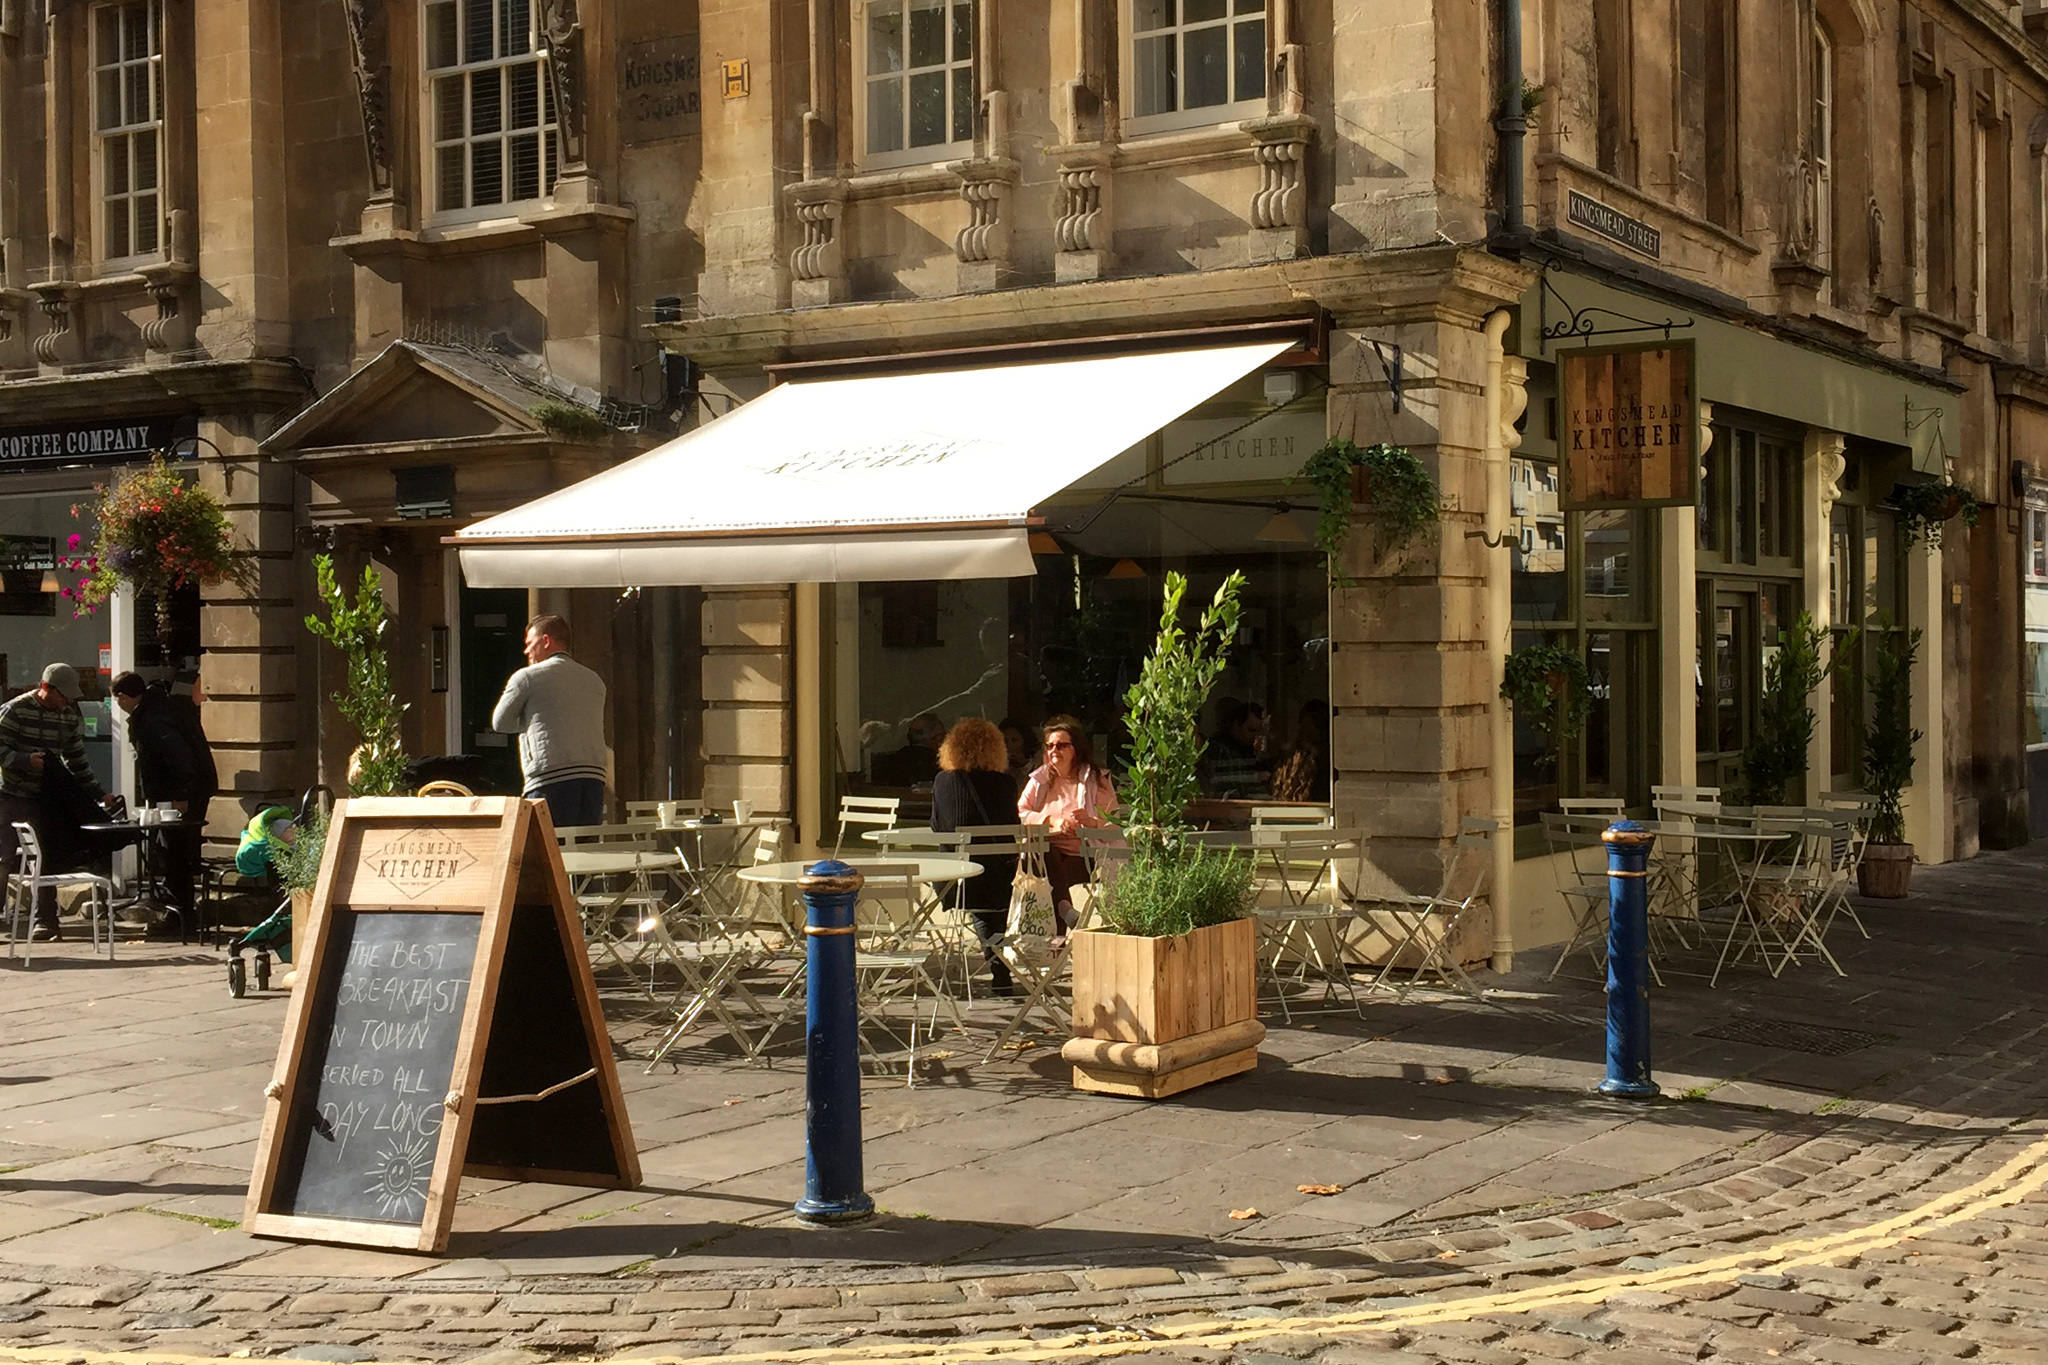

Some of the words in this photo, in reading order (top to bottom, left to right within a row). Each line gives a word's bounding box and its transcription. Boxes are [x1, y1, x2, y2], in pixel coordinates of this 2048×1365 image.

[1571, 196, 1625, 237] KINGSMEAD
[1628, 223, 1658, 252] STREET
[1572, 403, 1681, 424] KINGSMEAD
[0, 433, 61, 458] COFFEE
[66, 426, 149, 453] COMPANY
[1194, 436, 1294, 461] KITCHEN
[1572, 424, 1682, 450] KITCHEN
[383, 842, 463, 855] KINGSMEAD
[377, 859, 460, 878] KITCHEN
[351, 940, 383, 968] THE
[391, 940, 457, 969] BEST
[337, 972, 470, 1024] BREAKFAST
[360, 1019, 430, 1051] TOWN
[321, 1064, 384, 1087] SERVED
[392, 1066, 430, 1100] ALL
[319, 1101, 370, 1163] DAY
[373, 1100, 443, 1136] LONG
